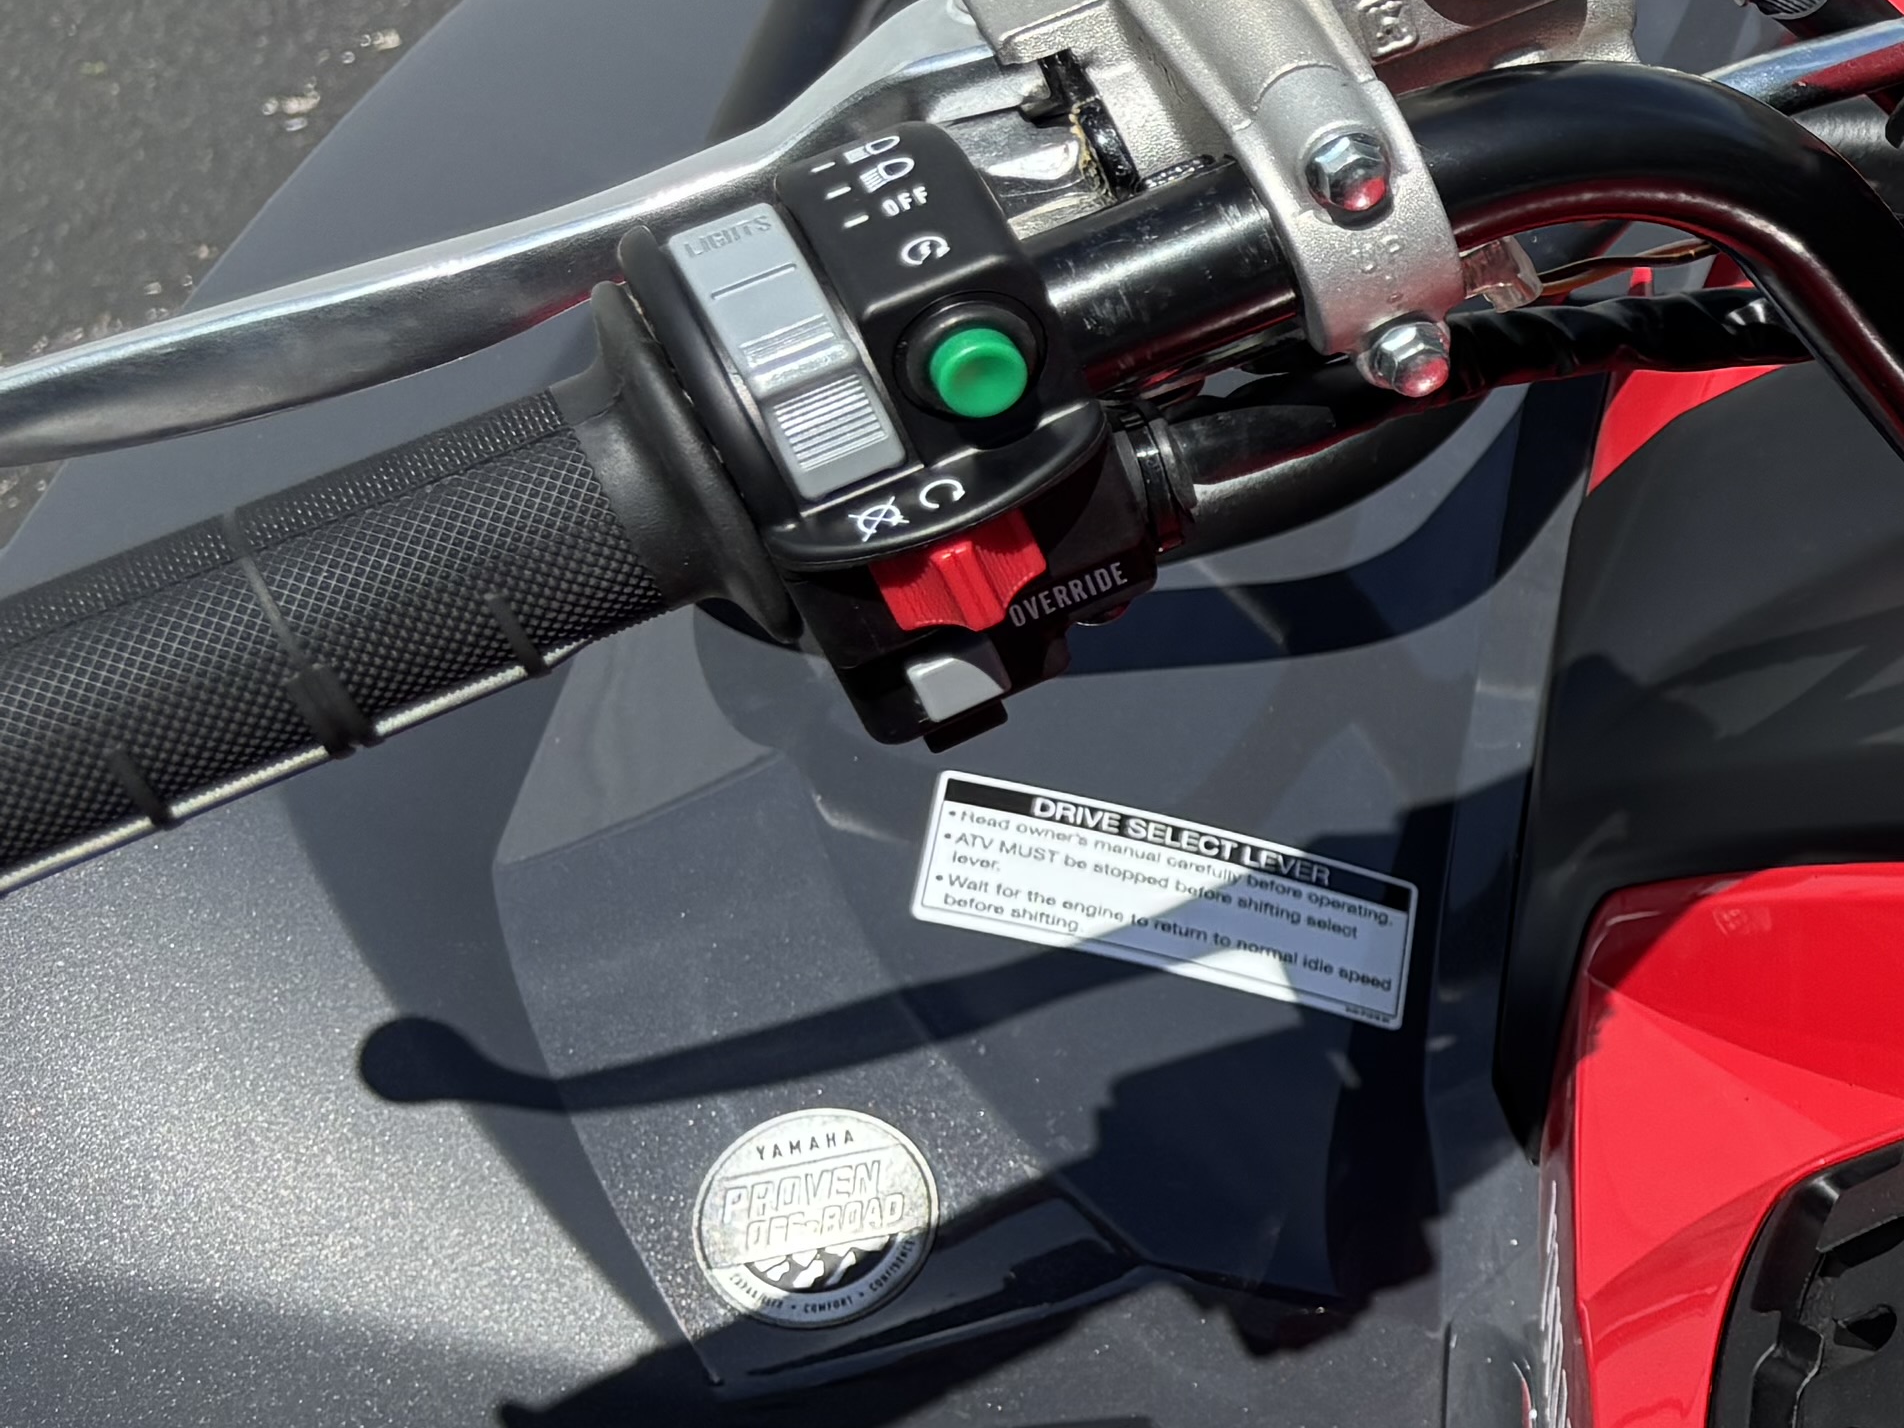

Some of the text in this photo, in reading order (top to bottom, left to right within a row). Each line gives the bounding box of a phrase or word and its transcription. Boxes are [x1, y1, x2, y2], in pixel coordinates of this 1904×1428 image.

[882, 187, 929, 217] OFF
[683, 213, 771, 259] LIGHTS
[1008, 562, 1129, 628] OVERRIDE
[951, 850, 999, 870] lever.
[1031, 797, 1331, 886] DRIVE SELECT LEVER
[954, 832, 1357, 938] ATV MUST be stopped before shifting select
[1015, 822, 1087, 846] owner's
[1093, 839, 1161, 862] manual
[1166, 856, 1241, 886] carefully
[1246, 873, 1302, 899] before
[1306, 892, 1391, 925] operating.
[943, 892, 1081, 932] before shifting.
[948, 873, 1392, 991] Wait for the engine to return to normal idle speed
[756, 1129, 855, 1161] YAMAHA
[722, 1160, 881, 1223] PROVEN
[868, 1239, 917, 1292] CONFIDENCE
[804, 1296, 854, 1313] COMFORT
